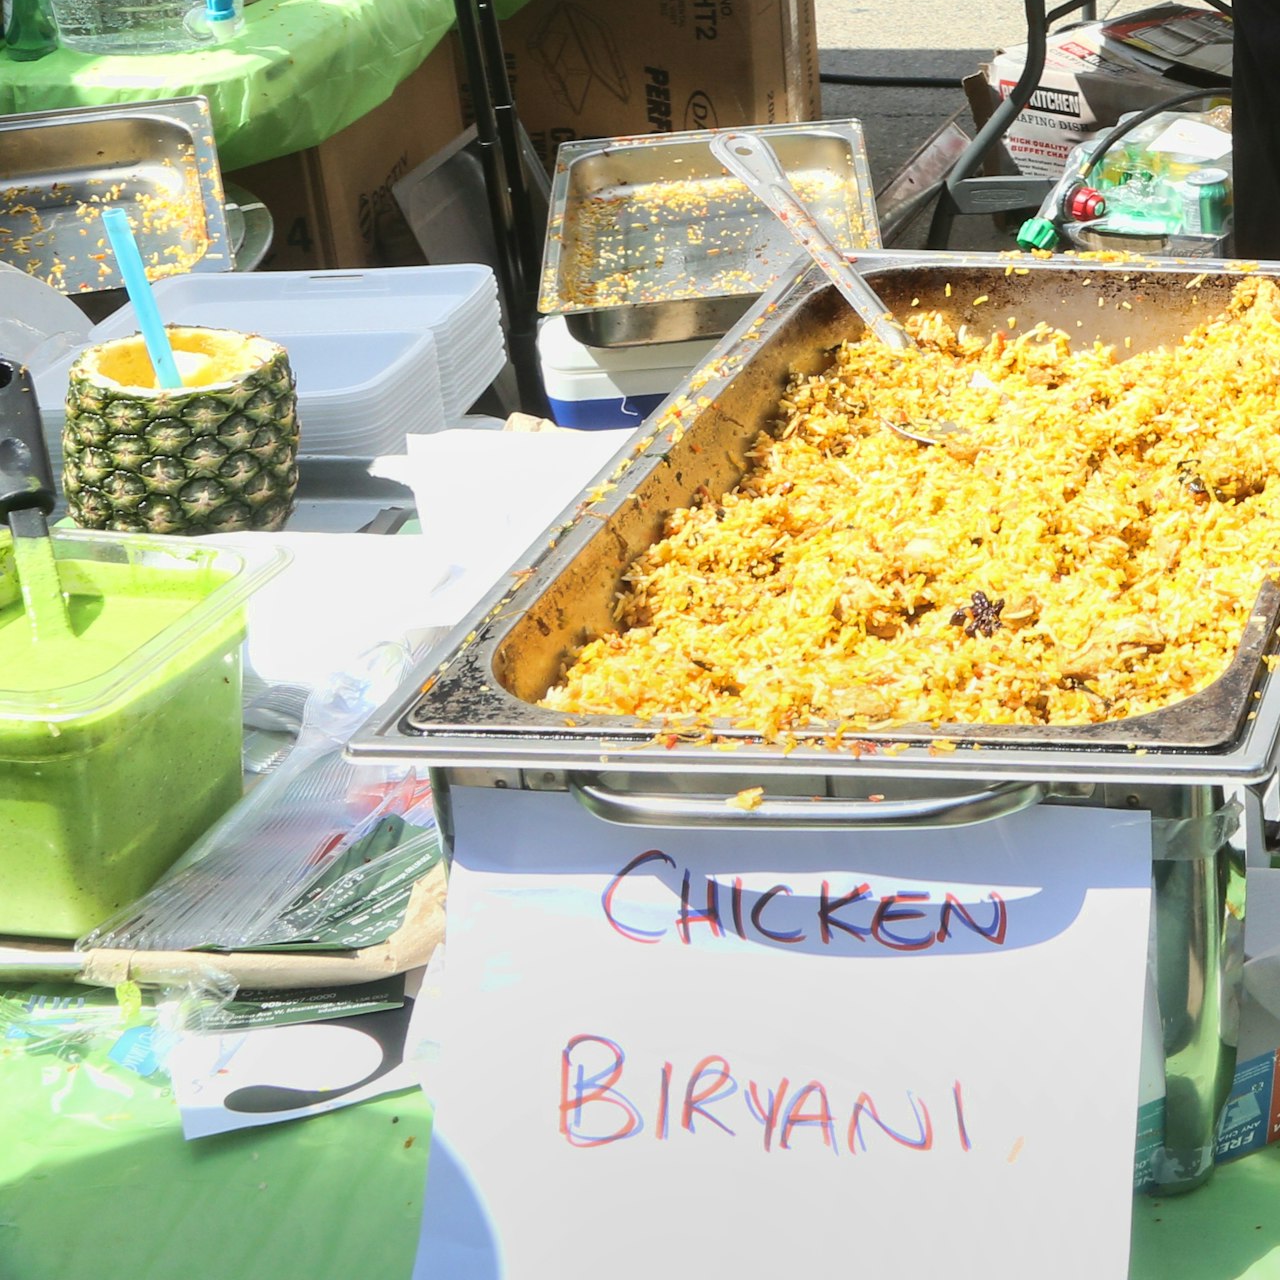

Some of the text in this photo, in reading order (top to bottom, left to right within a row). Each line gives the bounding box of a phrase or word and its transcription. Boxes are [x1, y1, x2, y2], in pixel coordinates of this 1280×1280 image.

[1010, 145, 1045, 156] BUFFET
[1033, 140, 1069, 152] QUALITY
[600, 848, 1008, 951] CHICKEN
[558, 1033, 973, 1156] BIRYANI
[1240, 1120, 1261, 1134] ANY
